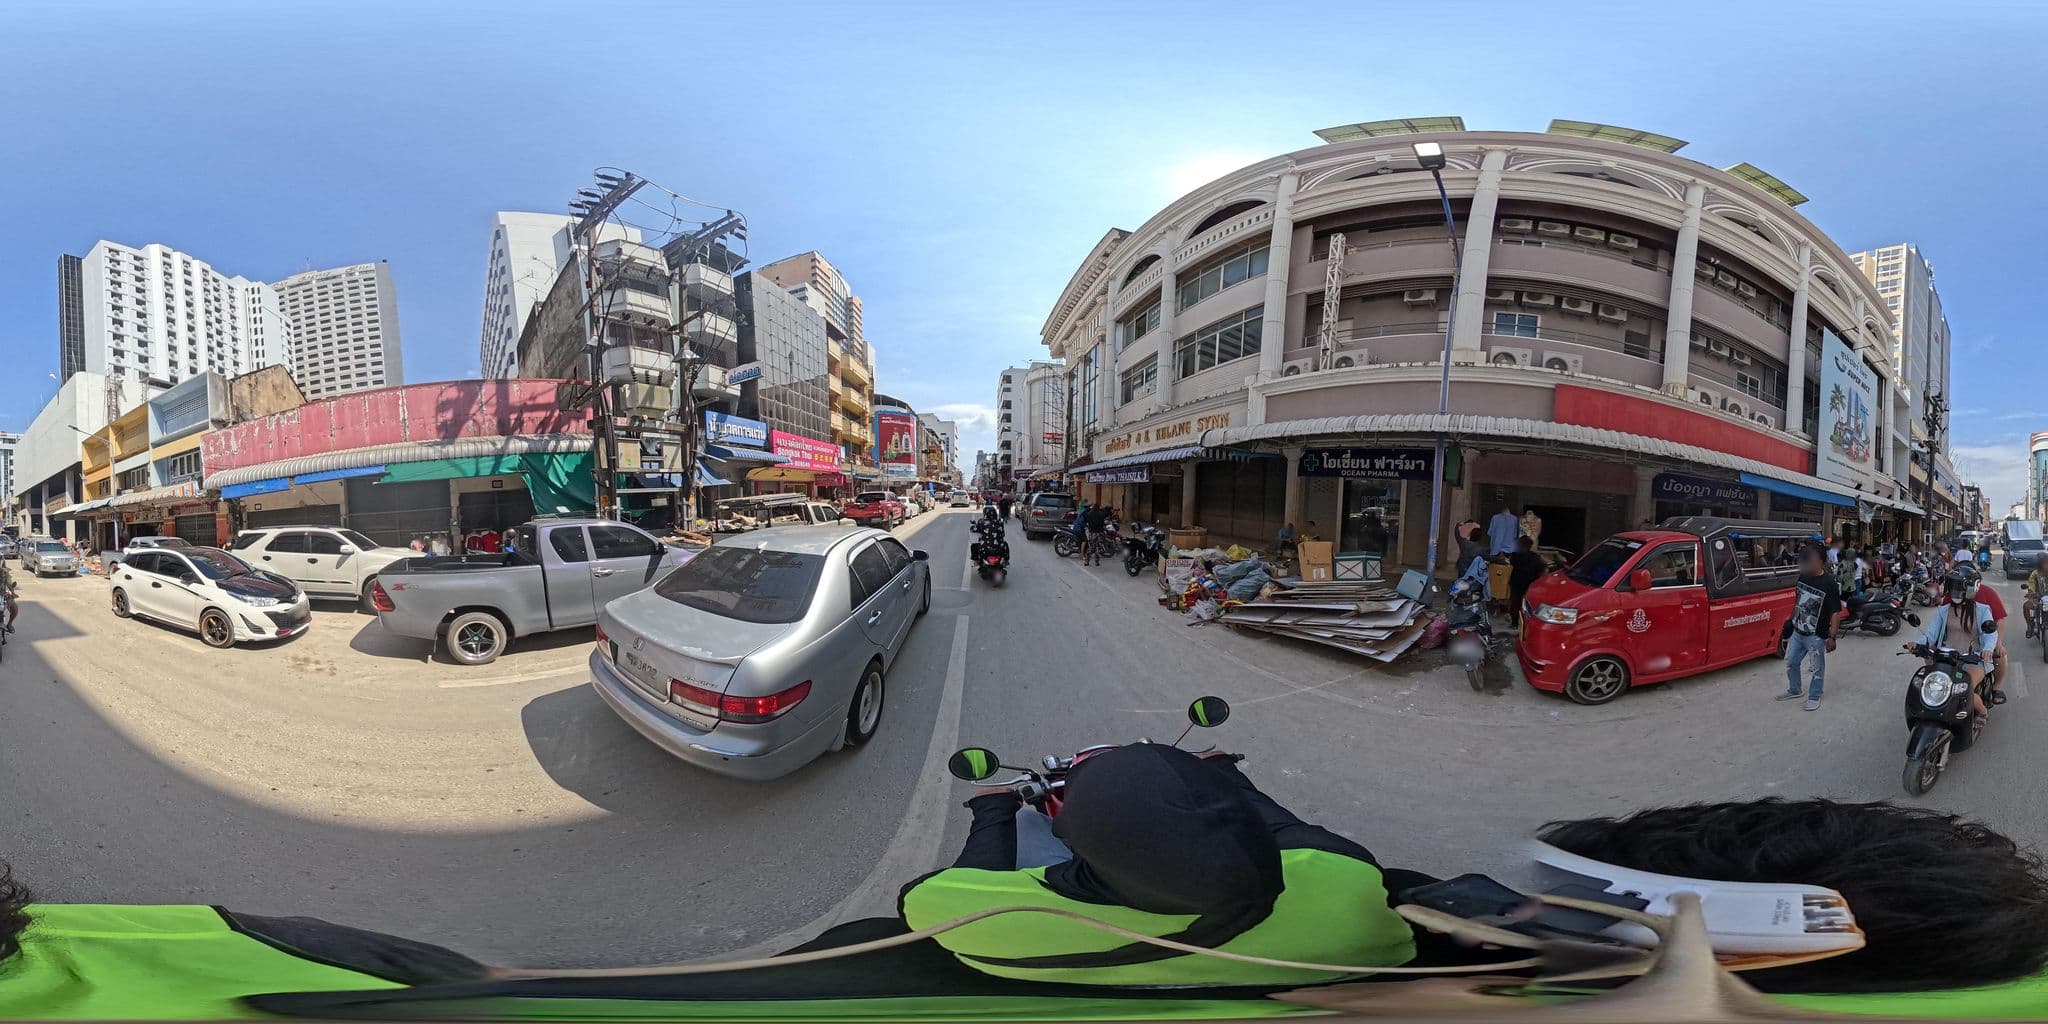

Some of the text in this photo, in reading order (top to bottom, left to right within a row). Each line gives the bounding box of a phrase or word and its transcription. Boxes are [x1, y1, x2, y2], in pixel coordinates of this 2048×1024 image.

[1321, 450, 1426, 471] โอเชี่ยน ฟาร์มา
[1341, 469, 1400, 478] OCEAN PHARMA
